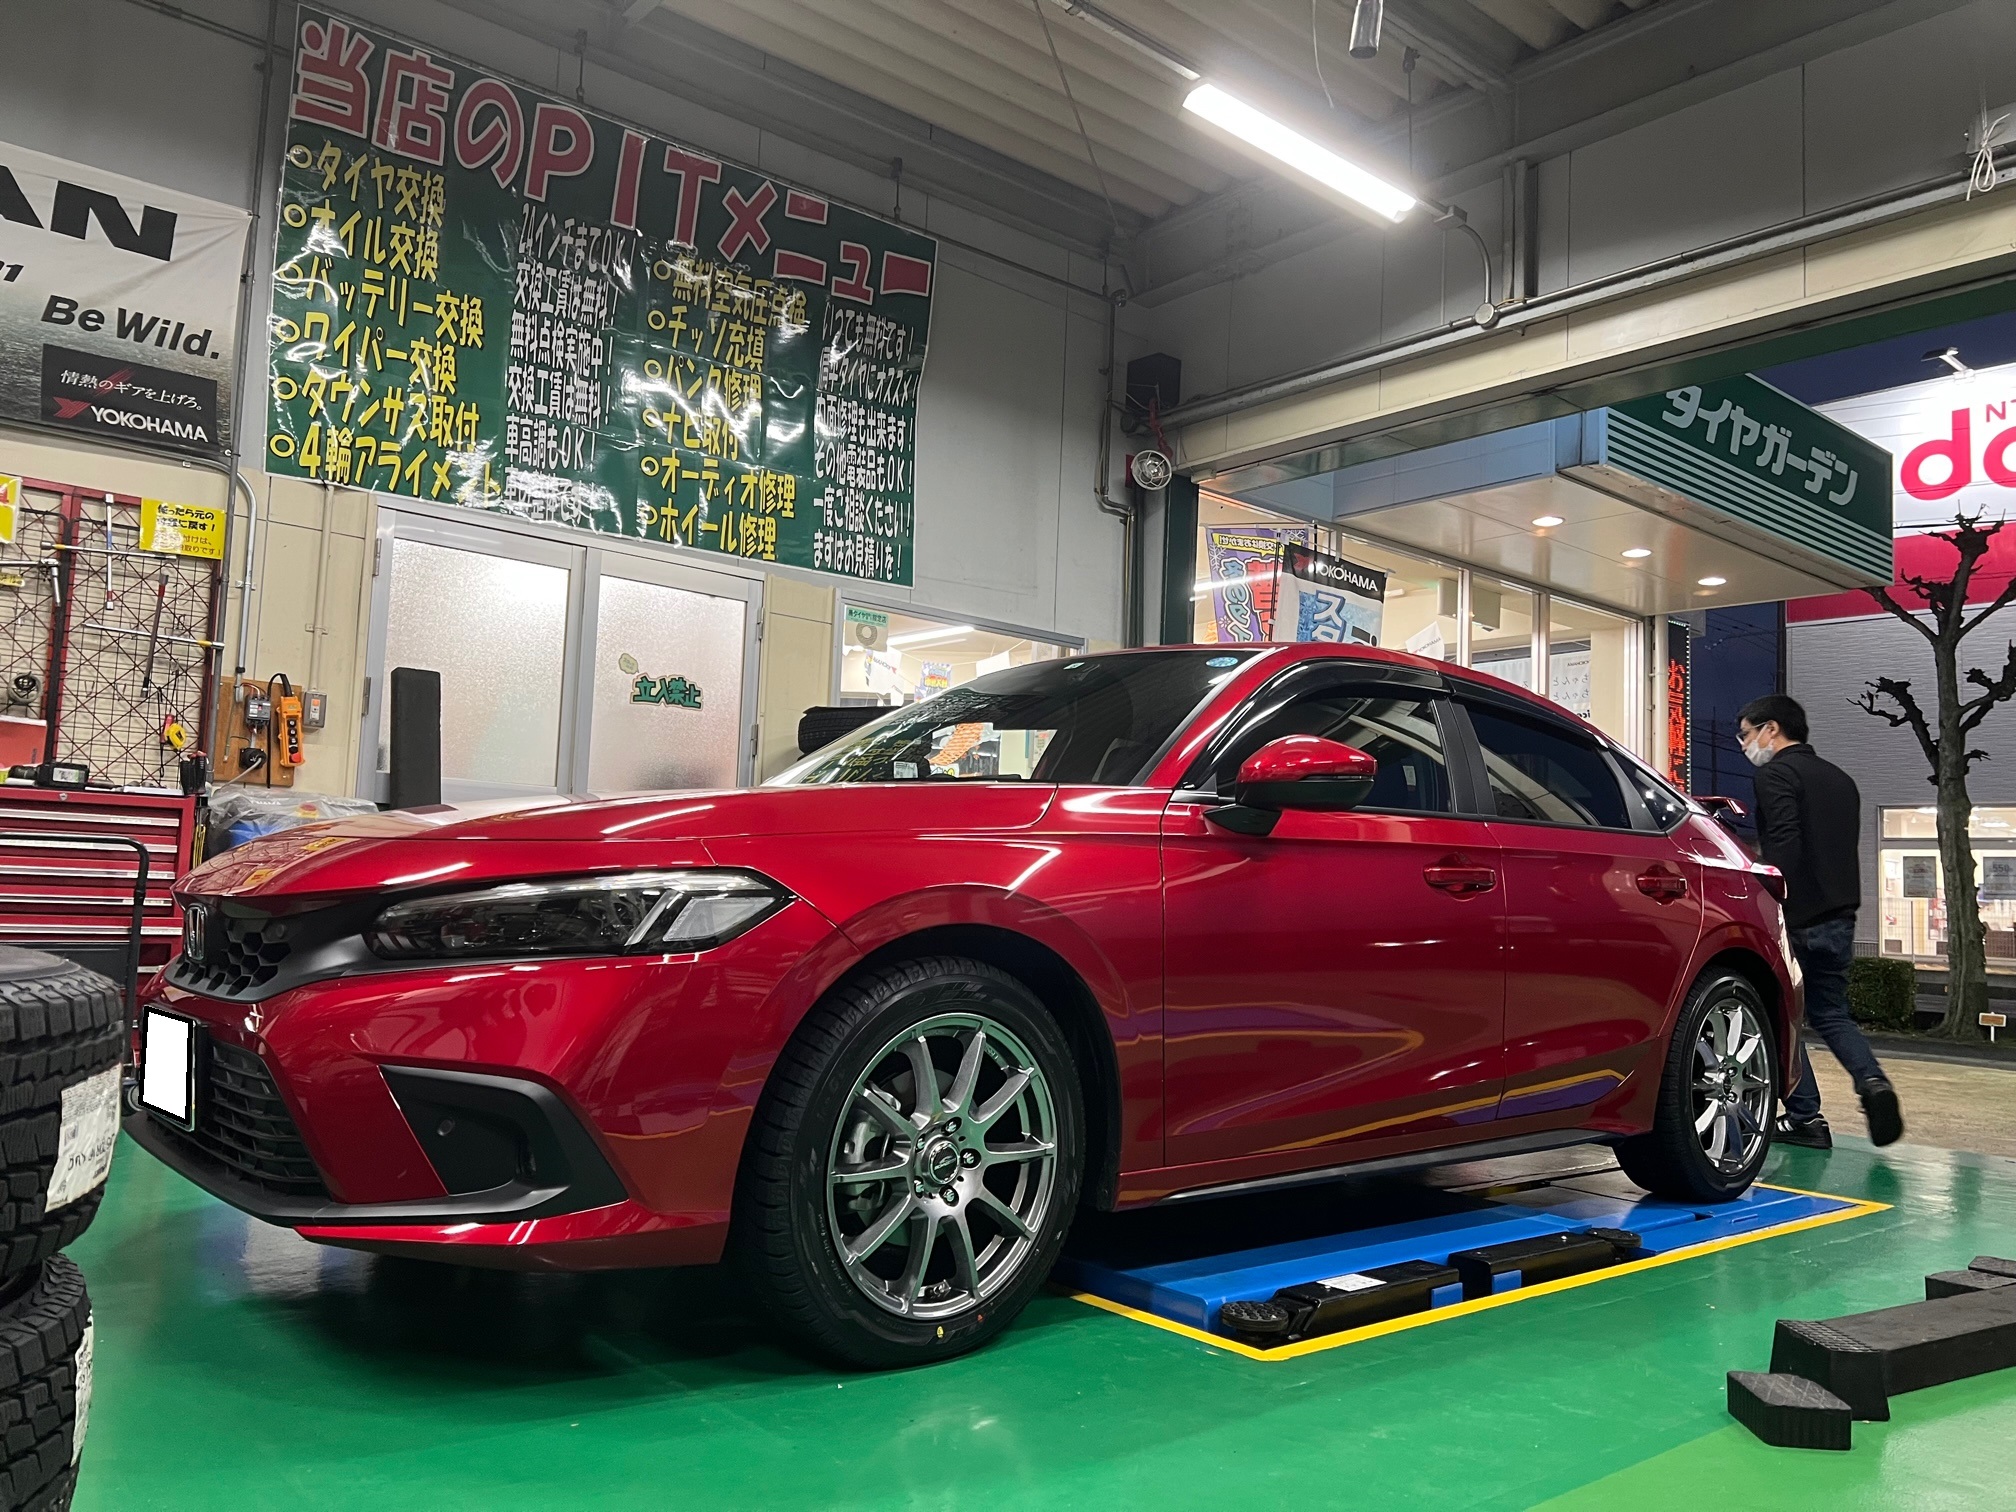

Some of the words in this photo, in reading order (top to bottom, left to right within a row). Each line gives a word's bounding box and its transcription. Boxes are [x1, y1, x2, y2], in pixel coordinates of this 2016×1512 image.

[291, 18, 931, 305] 当店のPITメニュー
[41, 294, 105, 332] Be
[116, 307, 220, 360] Wild.
[60, 369, 202, 411] 情熱のギアを上げろ。
[90, 405, 209, 442] YOKOHAMA
[1661, 385, 1859, 506] タイヤガーデン
[1313, 560, 1379, 592] YOKOHAMA
[633, 675, 701, 709] 立入禁止
